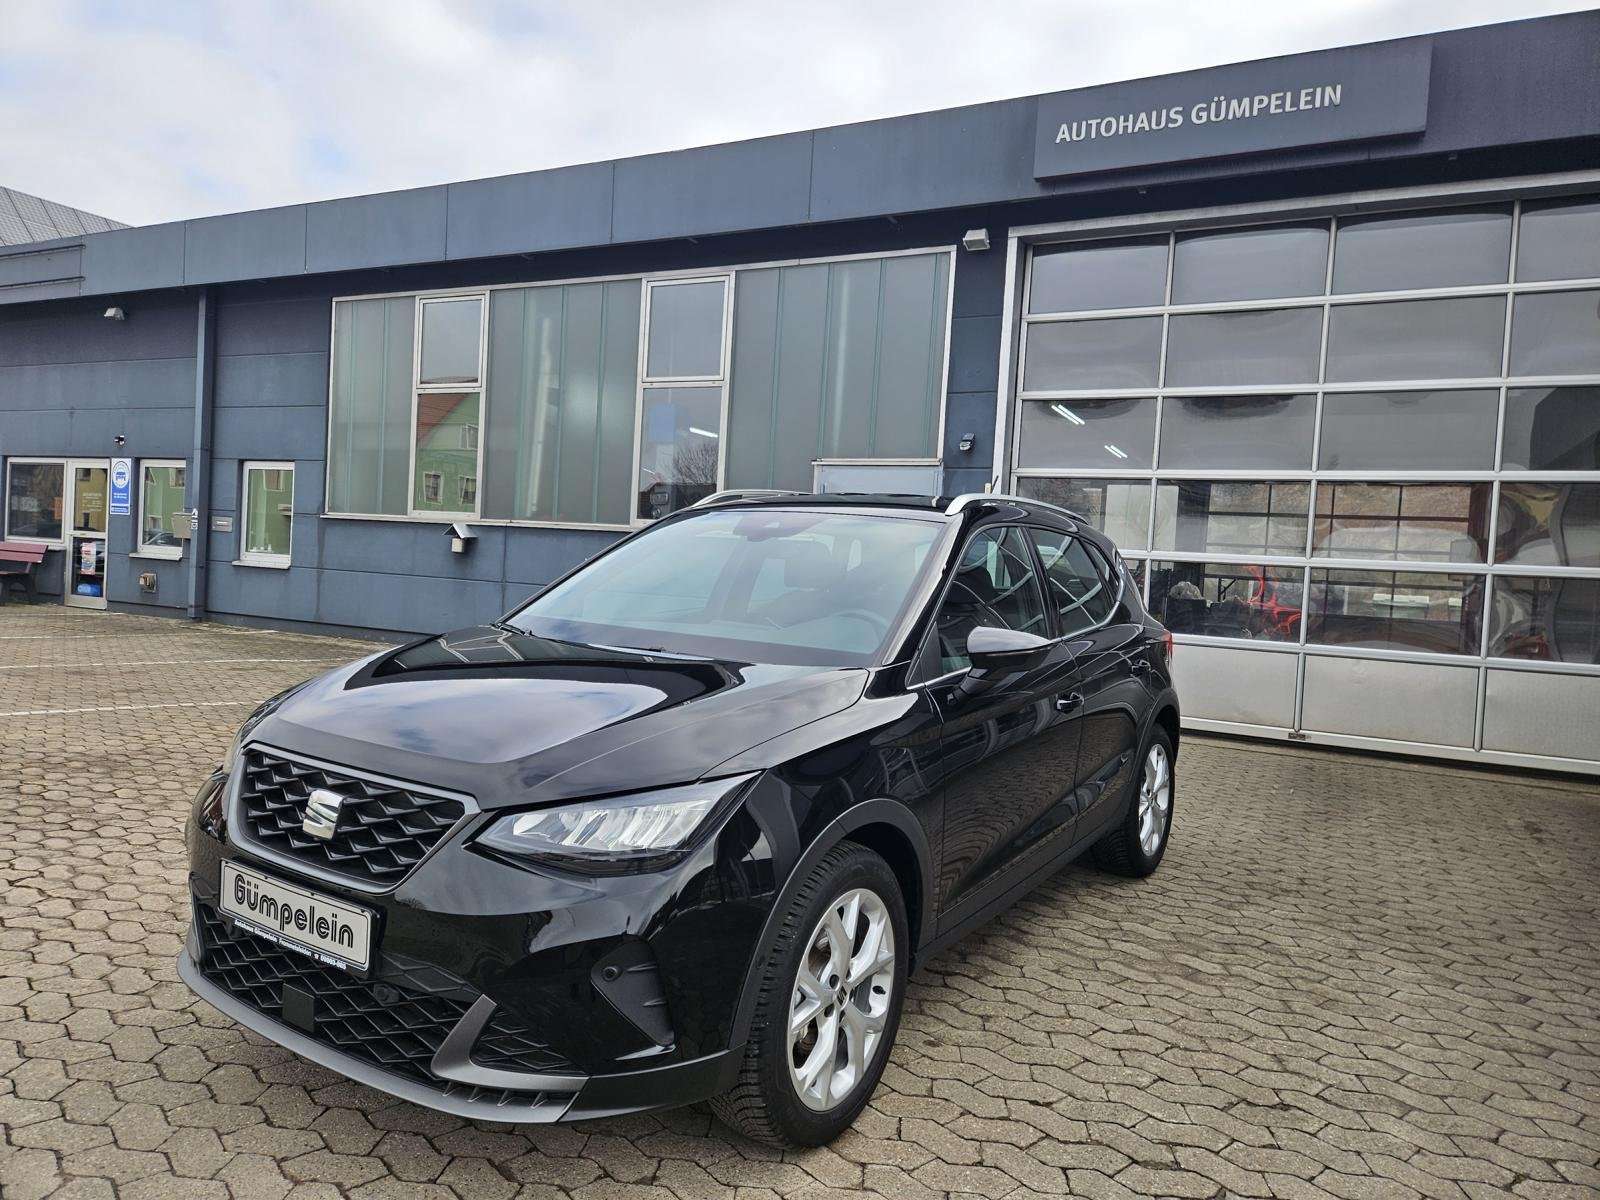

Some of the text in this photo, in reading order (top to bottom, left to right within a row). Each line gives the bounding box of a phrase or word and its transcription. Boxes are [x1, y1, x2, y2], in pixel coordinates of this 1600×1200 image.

[1055, 84, 1343, 144] AUTOHAUS GÜMPELEIN
[234, 873, 354, 949] Gümpelein
